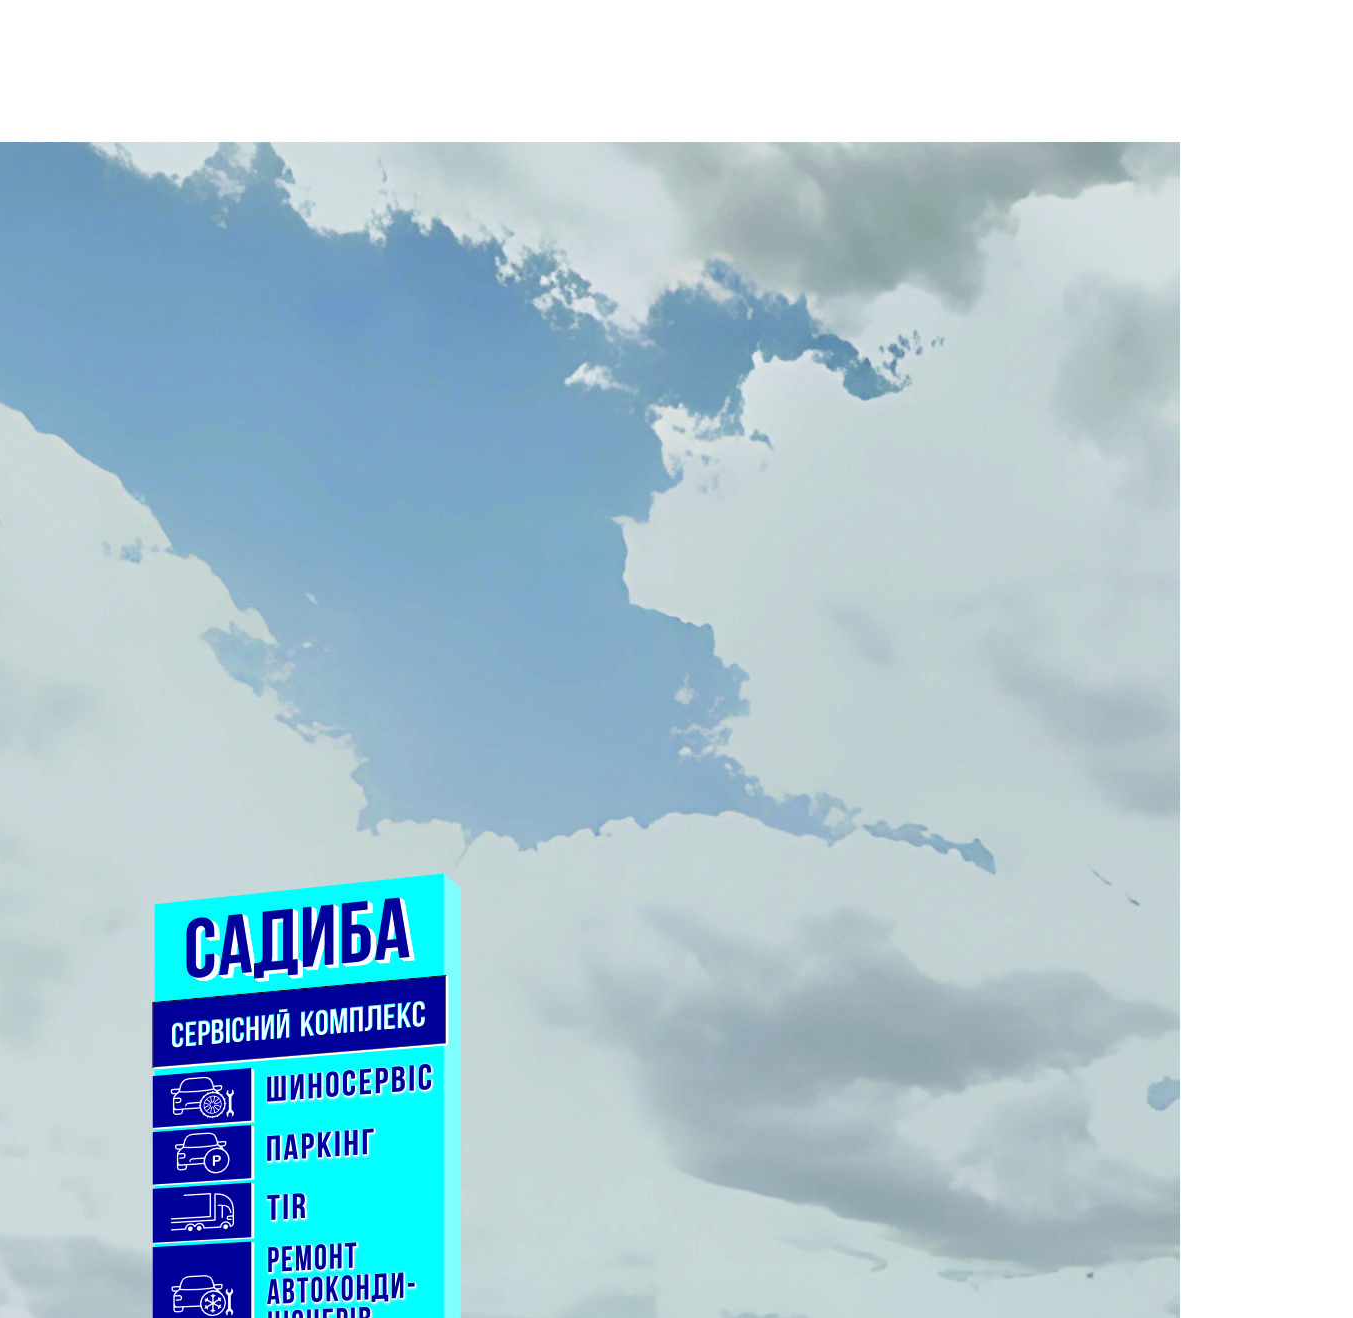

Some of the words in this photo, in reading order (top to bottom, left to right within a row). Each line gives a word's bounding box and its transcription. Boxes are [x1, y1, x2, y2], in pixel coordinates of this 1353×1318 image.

[185, 897, 410, 980] САДИБА
[171, 1009, 290, 1048] СЕРВІСНИЙ
[300, 1001, 425, 1037] КОМПЛЕКС
[266, 1063, 432, 1103] ШИНОСЕРВІС
[266, 1128, 375, 1162] ПАРКІНГ
[266, 1192, 306, 1221] TIR
[267, 1241, 357, 1273] РЕМОНТ
[266, 1271, 416, 1305] АВТОКОНДИ-
